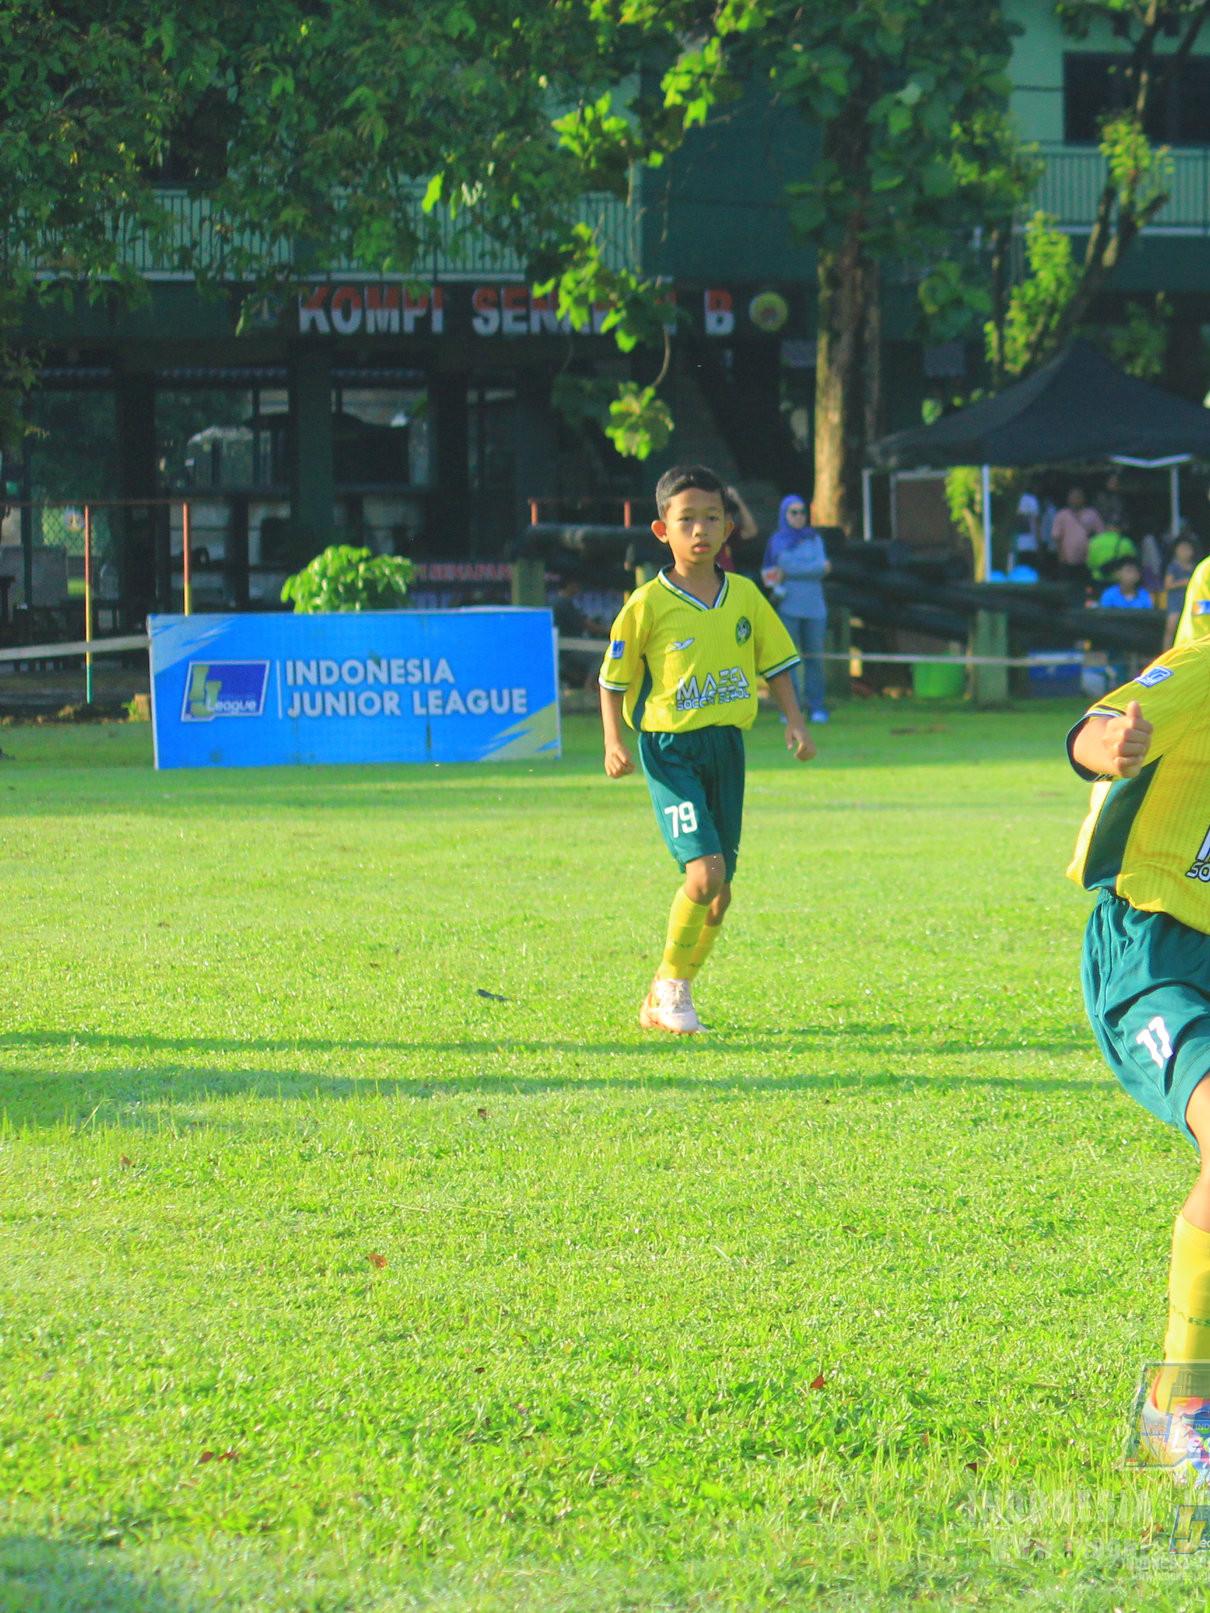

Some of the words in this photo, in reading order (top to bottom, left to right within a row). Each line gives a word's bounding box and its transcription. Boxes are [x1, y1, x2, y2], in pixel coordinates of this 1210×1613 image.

[300, 286, 443, 334] KOMPI
[704, 289, 735, 335] B
[286, 658, 455, 686] INDONESIA
[288, 690, 401, 718] JUNIOR
[413, 688, 528, 716] LEAGUE
[664, 801, 698, 838] 79
